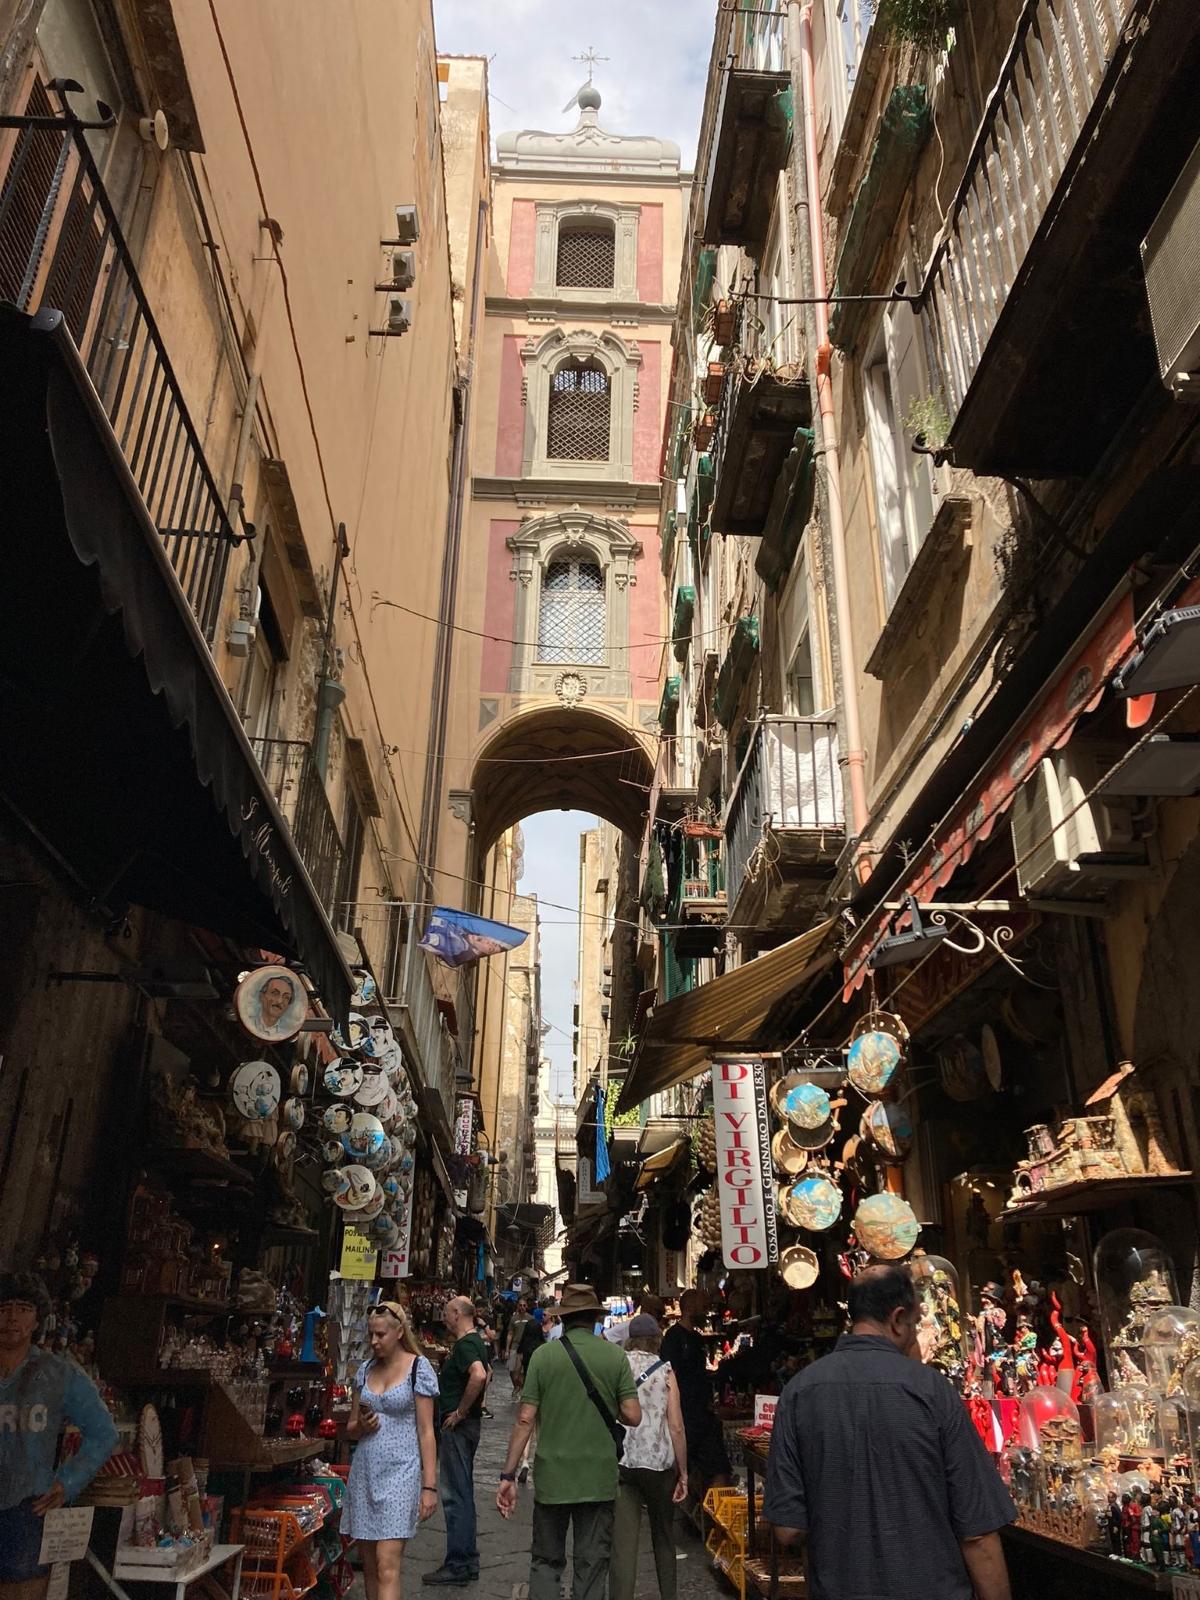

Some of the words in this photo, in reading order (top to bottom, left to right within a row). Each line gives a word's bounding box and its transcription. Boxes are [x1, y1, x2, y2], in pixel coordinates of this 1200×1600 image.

[719, 1063, 748, 1100] DI
[754, 1063, 764, 1091] 1830
[757, 1095, 767, 1120] DAL
[759, 1123, 772, 1190] GENNARO
[721, 1112, 761, 1265] VIRGILIO
[765, 1203, 778, 1263] ROSARIO
